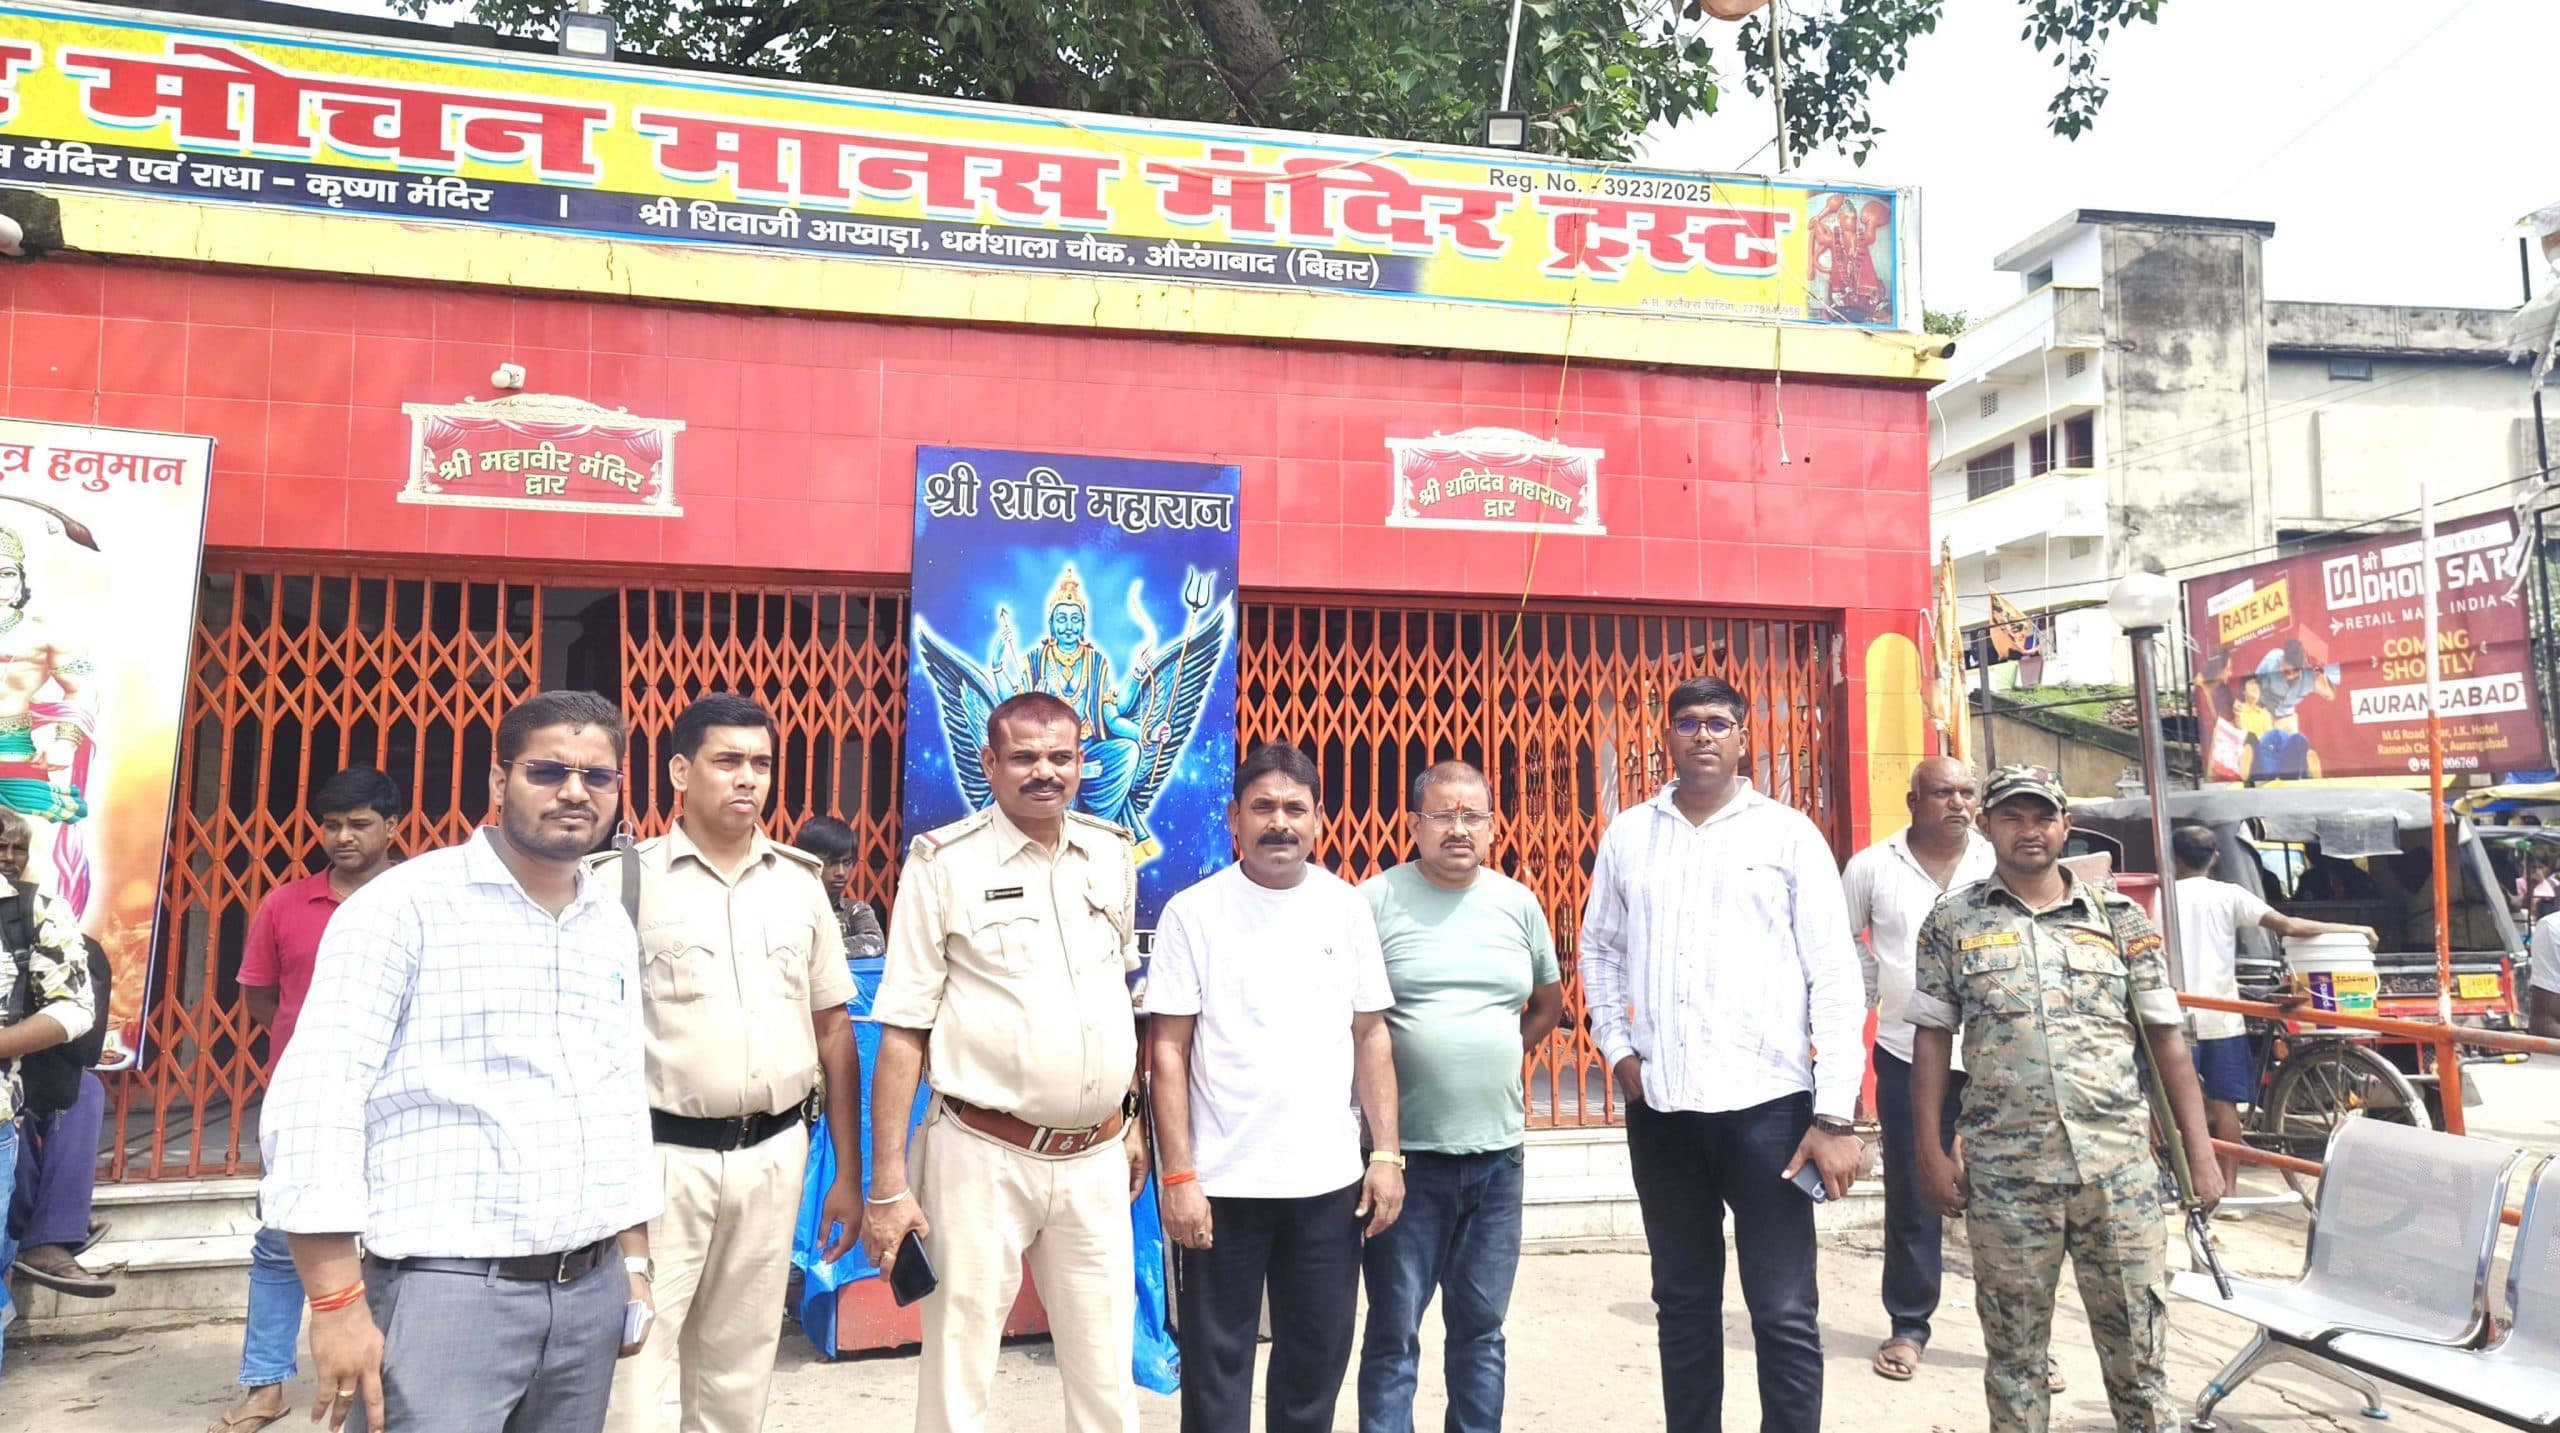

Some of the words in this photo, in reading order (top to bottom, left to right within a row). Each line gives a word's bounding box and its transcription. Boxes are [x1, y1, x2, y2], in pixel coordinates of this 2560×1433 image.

[66, 42, 606, 174] मोचन
[640, 112, 1119, 221] मानस
[1146, 148, 1513, 250] मंदिर
[1539, 196, 1790, 271] ट्रस्ट
[1490, 168, 1539, 198] Reg.
[1546, 172, 1584, 194] No.
[1604, 178, 1711, 204] 3923/2025
[23, 139, 122, 179] मंदिर
[128, 153, 188, 184] एवं
[190, 163, 264, 191] राधा
[306, 173, 397, 209] कृष्णा
[406, 178, 494, 212] मंदिर
[639, 197, 679, 229] श्री
[689, 200, 801, 240] शिवाजी
[806, 216, 930, 254] आखाड़ा,
[940, 224, 1058, 259] धर्मशाला
[1066, 233, 1134, 267] चौक,
[1144, 238, 1276, 275] औरंगाबाद
[1285, 246, 1381, 286] (बिहार)
[47, 447, 187, 492] हनुमान
[438, 448, 473, 481] श्री
[479, 440, 575, 473] महावीर
[578, 450, 645, 493] मंदिर
[524, 474, 568, 496] द्वार
[924, 462, 980, 517] श्री
[990, 467, 1078, 523] शनि
[1087, 487, 1233, 533] महाराज
[1418, 477, 1440, 506] श्री
[1445, 468, 1504, 498] शनिदेव
[1508, 475, 1573, 514] महाराज
[1483, 498, 1516, 518] द्वार
[2362, 551, 2379, 572] श्री
[2446, 546, 2515, 590] SAT
[2222, 601, 2259, 633] RATE
[2263, 590, 2284, 615] KA
[2345, 611, 2395, 630] RETAIL
[2402, 606, 2443, 622] MA
[2450, 595, 2498, 614] INDIA
[2383, 629, 2470, 659] COMNG
[2382, 651, 2476, 682] SHOTLY
[2402, 728, 2426, 740] Road
[2471, 722, 2498, 736] Hotel
